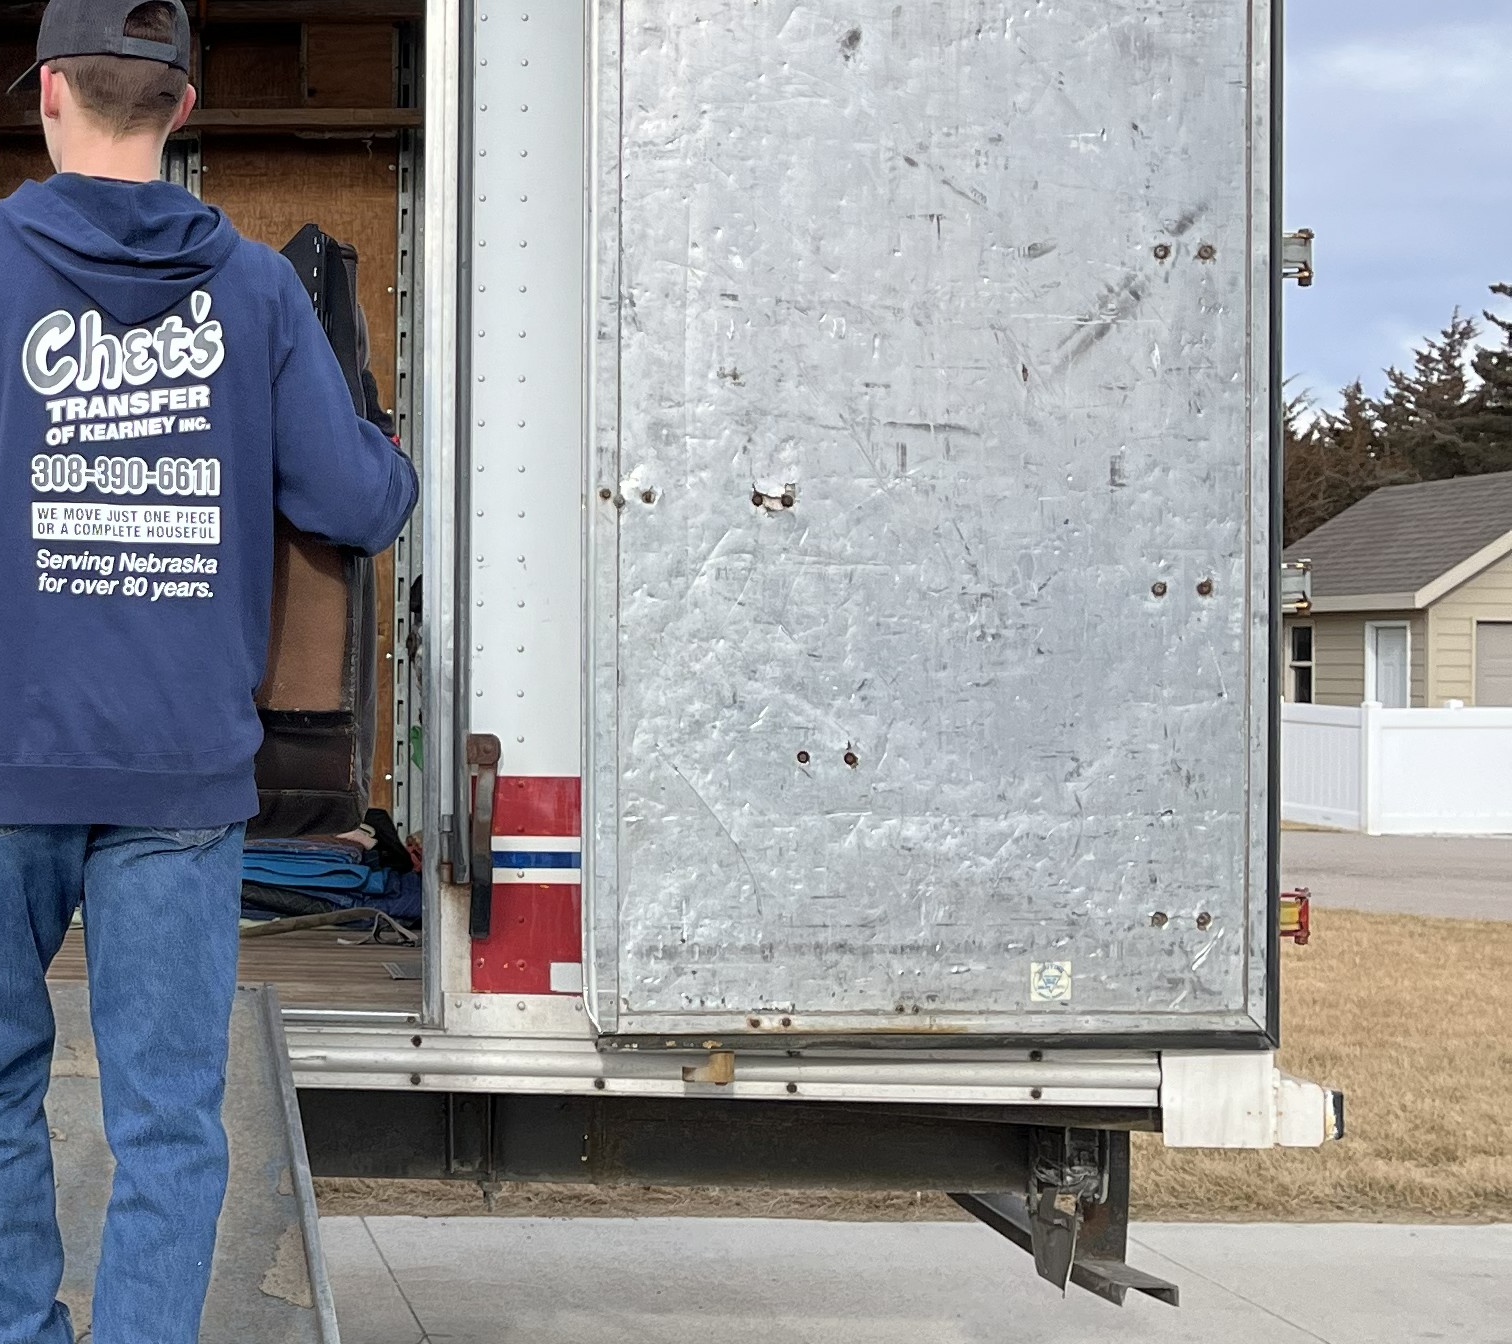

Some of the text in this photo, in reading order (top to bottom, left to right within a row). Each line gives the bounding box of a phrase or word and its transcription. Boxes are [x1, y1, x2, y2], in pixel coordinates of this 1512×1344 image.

[22, 290, 225, 395] Chet's
[45, 385, 211, 423] TRANSFER
[45, 415, 211, 446] OF KEARNEY INC.
[31, 454, 221, 496] 308-390-6611
[37, 508, 215, 524] WE MOVE JUST ONE PIECE
[37, 522, 215, 539] OR A COMPLETE HOUSEFUL
[36, 548, 218, 576] Serving Nebraska
[38, 572, 214, 602] for over 80 years.
